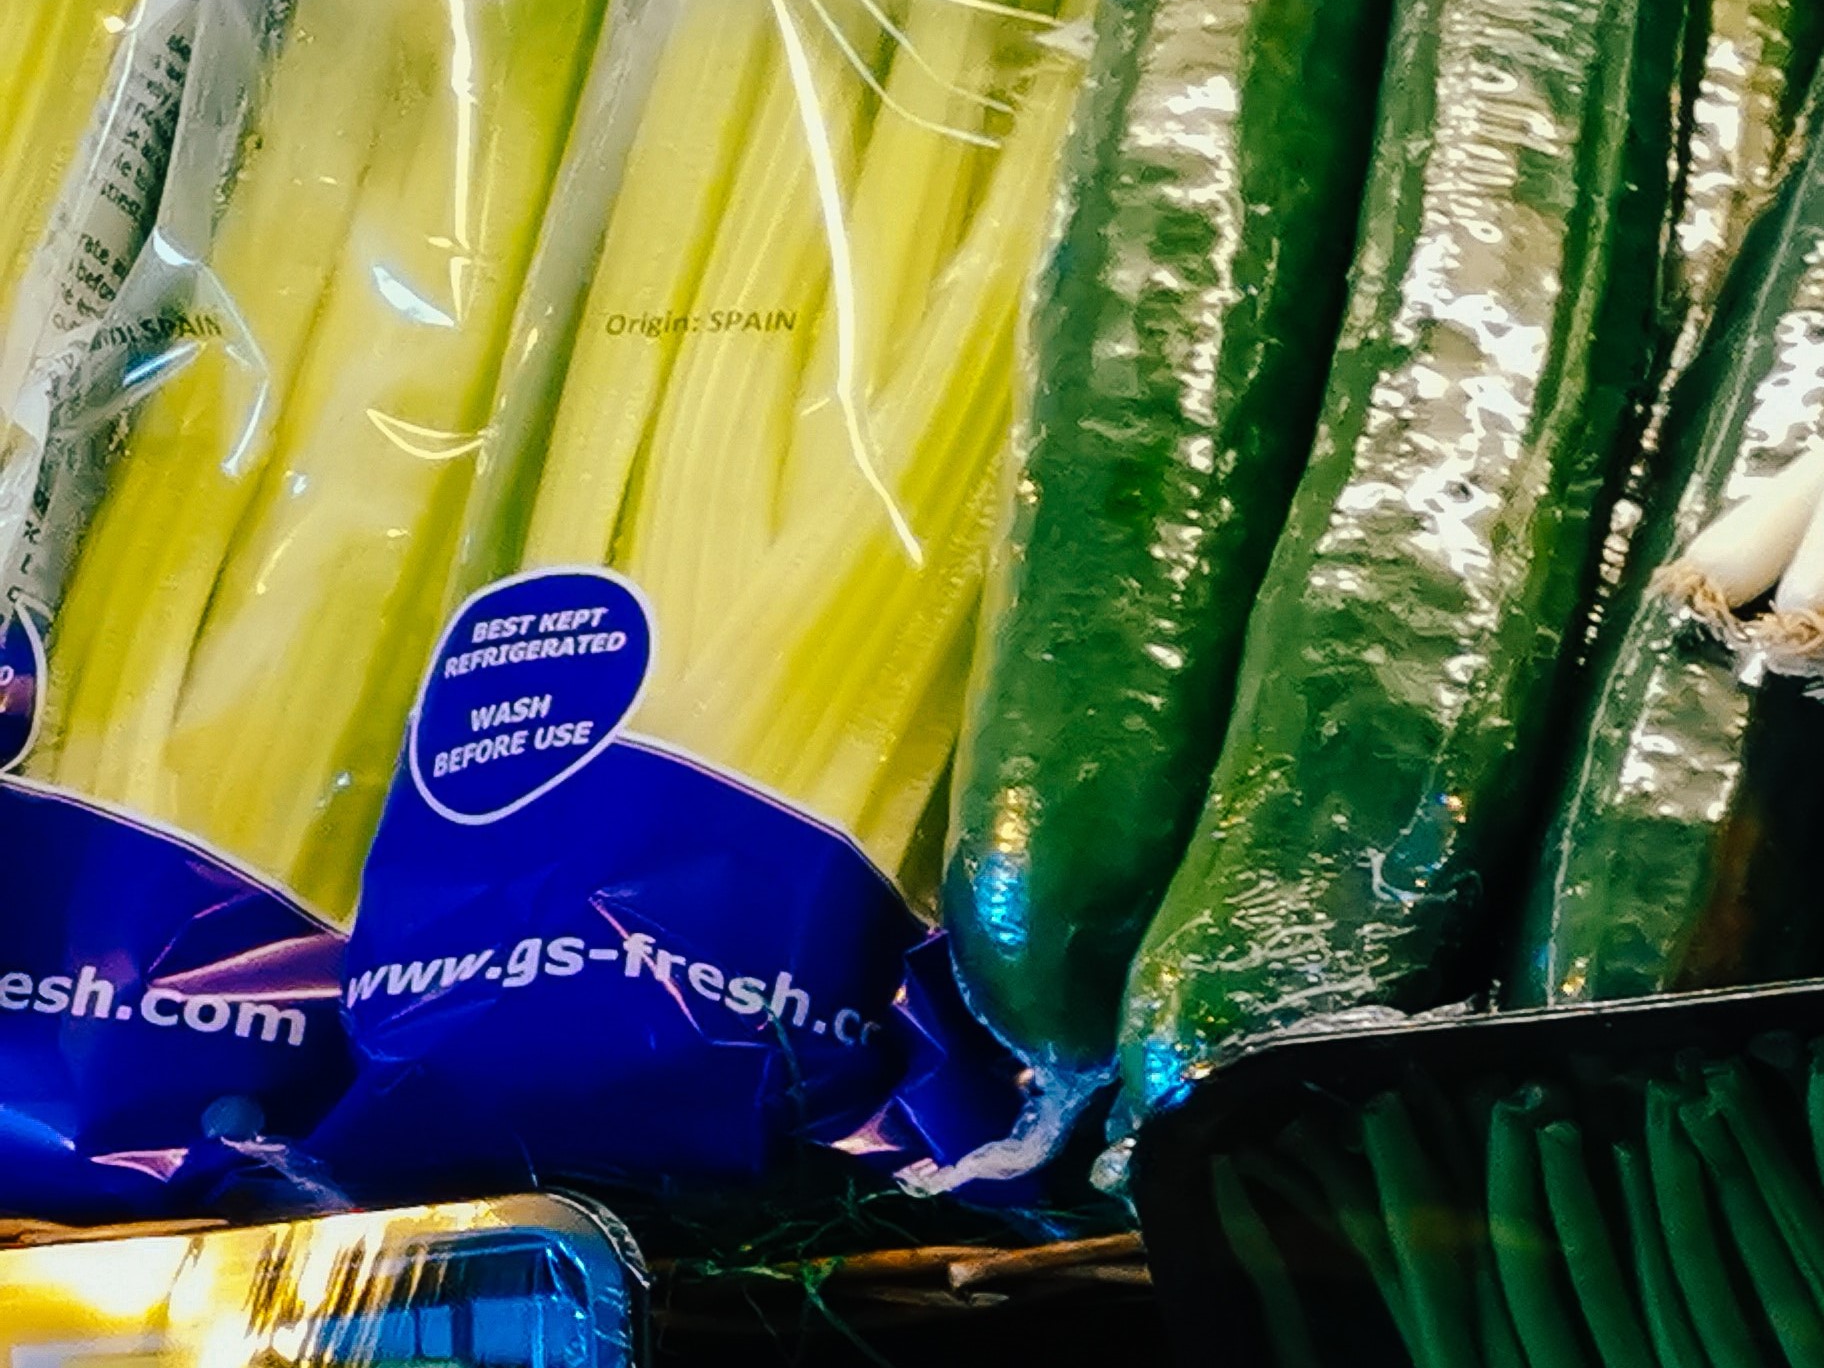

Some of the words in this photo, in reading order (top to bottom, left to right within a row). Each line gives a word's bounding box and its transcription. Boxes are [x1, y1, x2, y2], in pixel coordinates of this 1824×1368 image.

[605, 311, 699, 338] Origin:
[708, 309, 797, 332] SPAIN
[471, 615, 537, 644] BEST
[537, 607, 609, 633] KEPT
[444, 631, 627, 679] REFRIGERATED
[471, 694, 552, 732] WASH
[433, 731, 529, 777] BEFORE
[534, 721, 594, 749] USE
[0, 965, 306, 1046] esh.com
[346, 932, 881, 1046] www.gs-fresh.c
